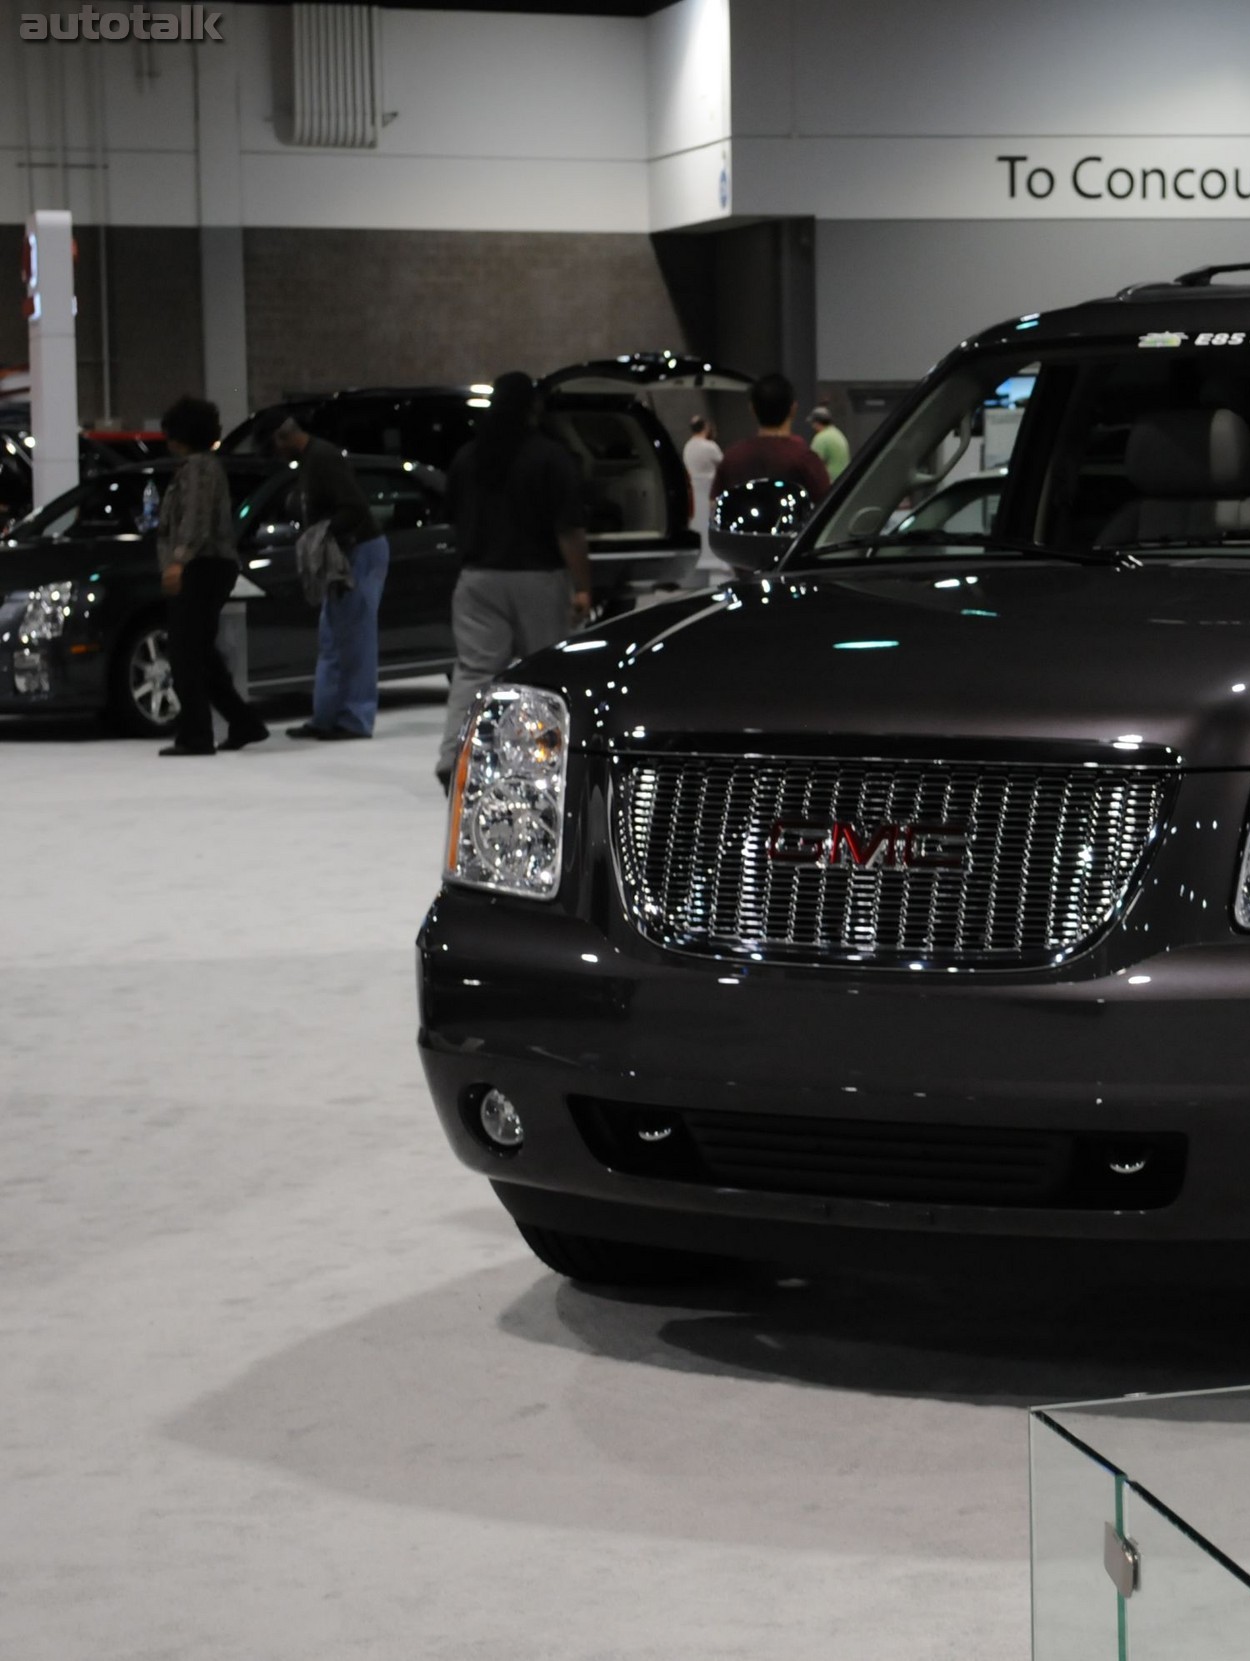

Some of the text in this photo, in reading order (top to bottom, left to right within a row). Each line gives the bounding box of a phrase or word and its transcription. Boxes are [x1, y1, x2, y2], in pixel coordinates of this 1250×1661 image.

[996, 156, 1055, 199] To
[1195, 332, 1246, 346] E85
[767, 820, 970, 868] GMC
